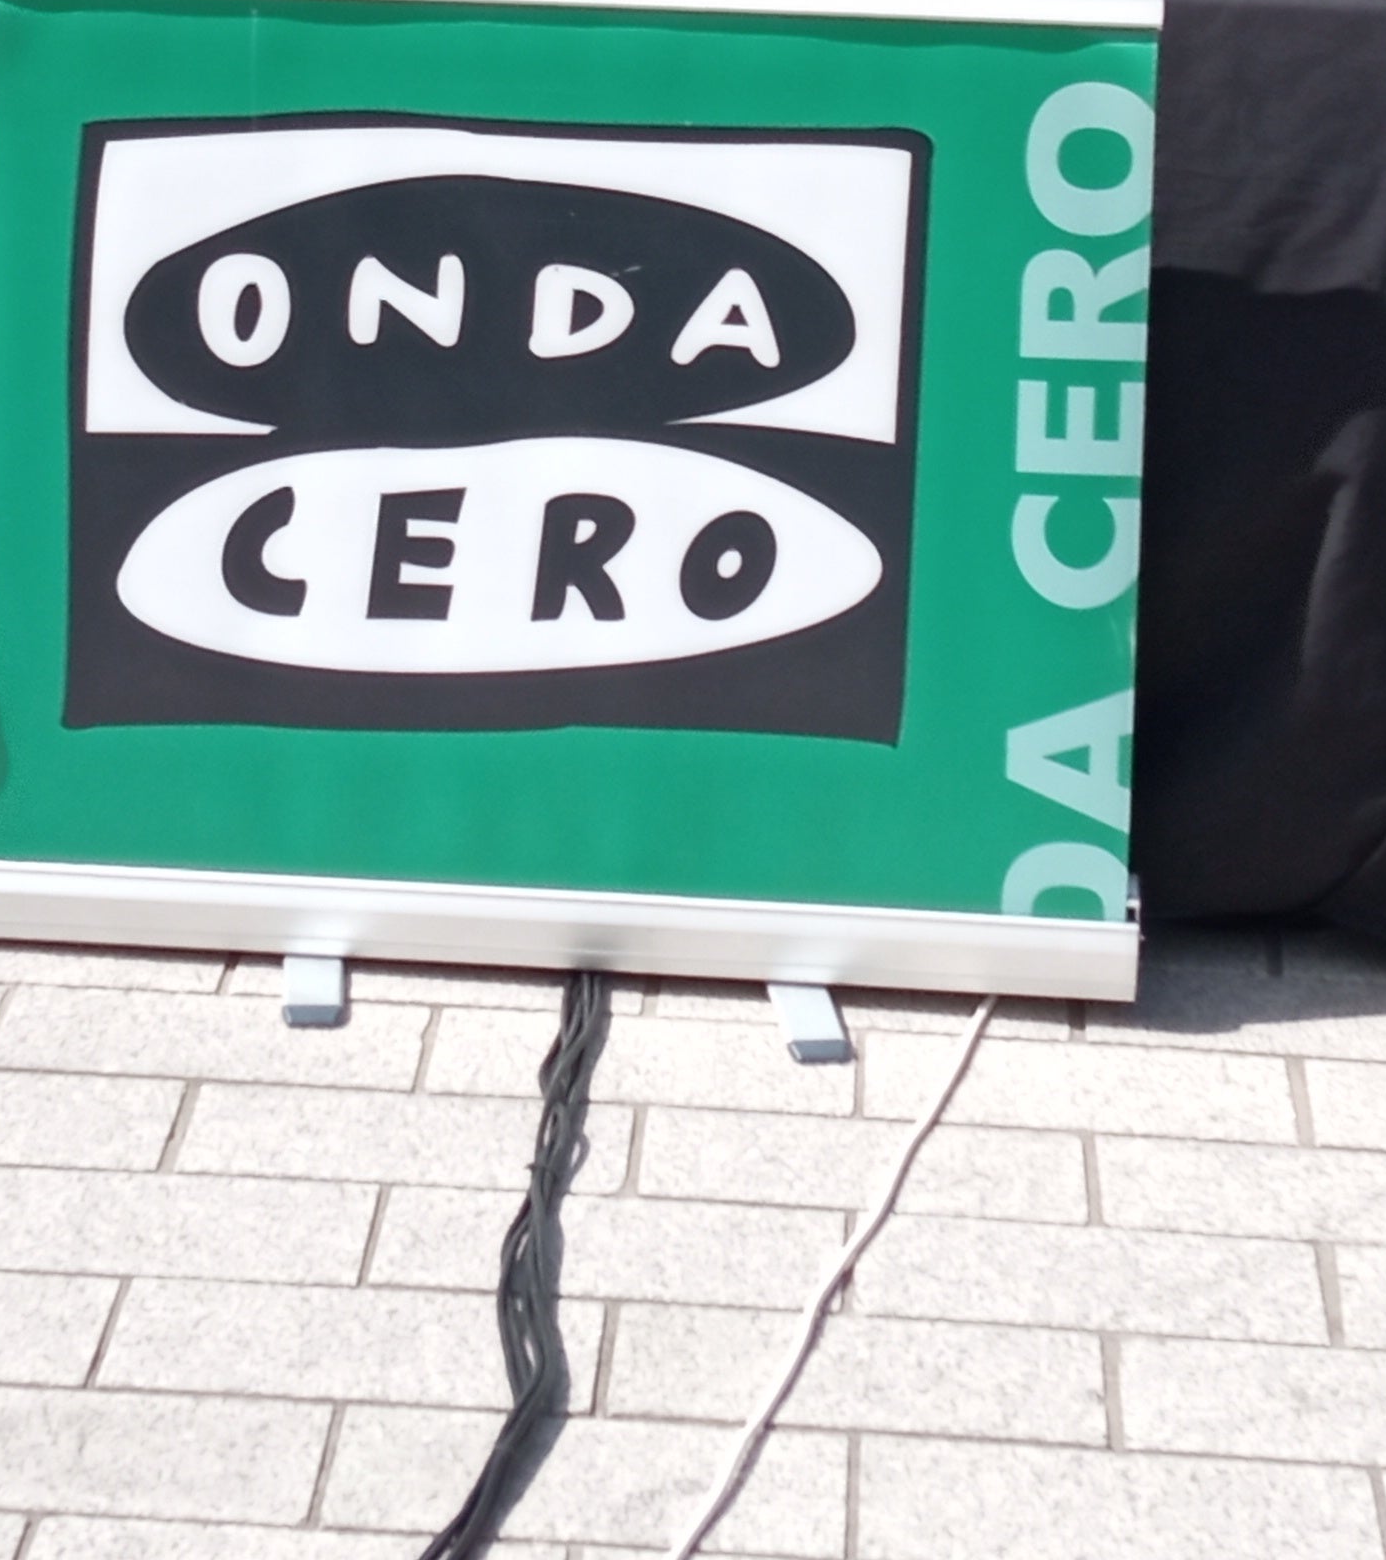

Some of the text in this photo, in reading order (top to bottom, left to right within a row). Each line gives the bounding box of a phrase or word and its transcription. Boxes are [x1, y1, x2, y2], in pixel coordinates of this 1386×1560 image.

[196, 250, 781, 369] ONDA
[1011, 80, 1155, 611] CERO
[220, 485, 778, 624] CERO
